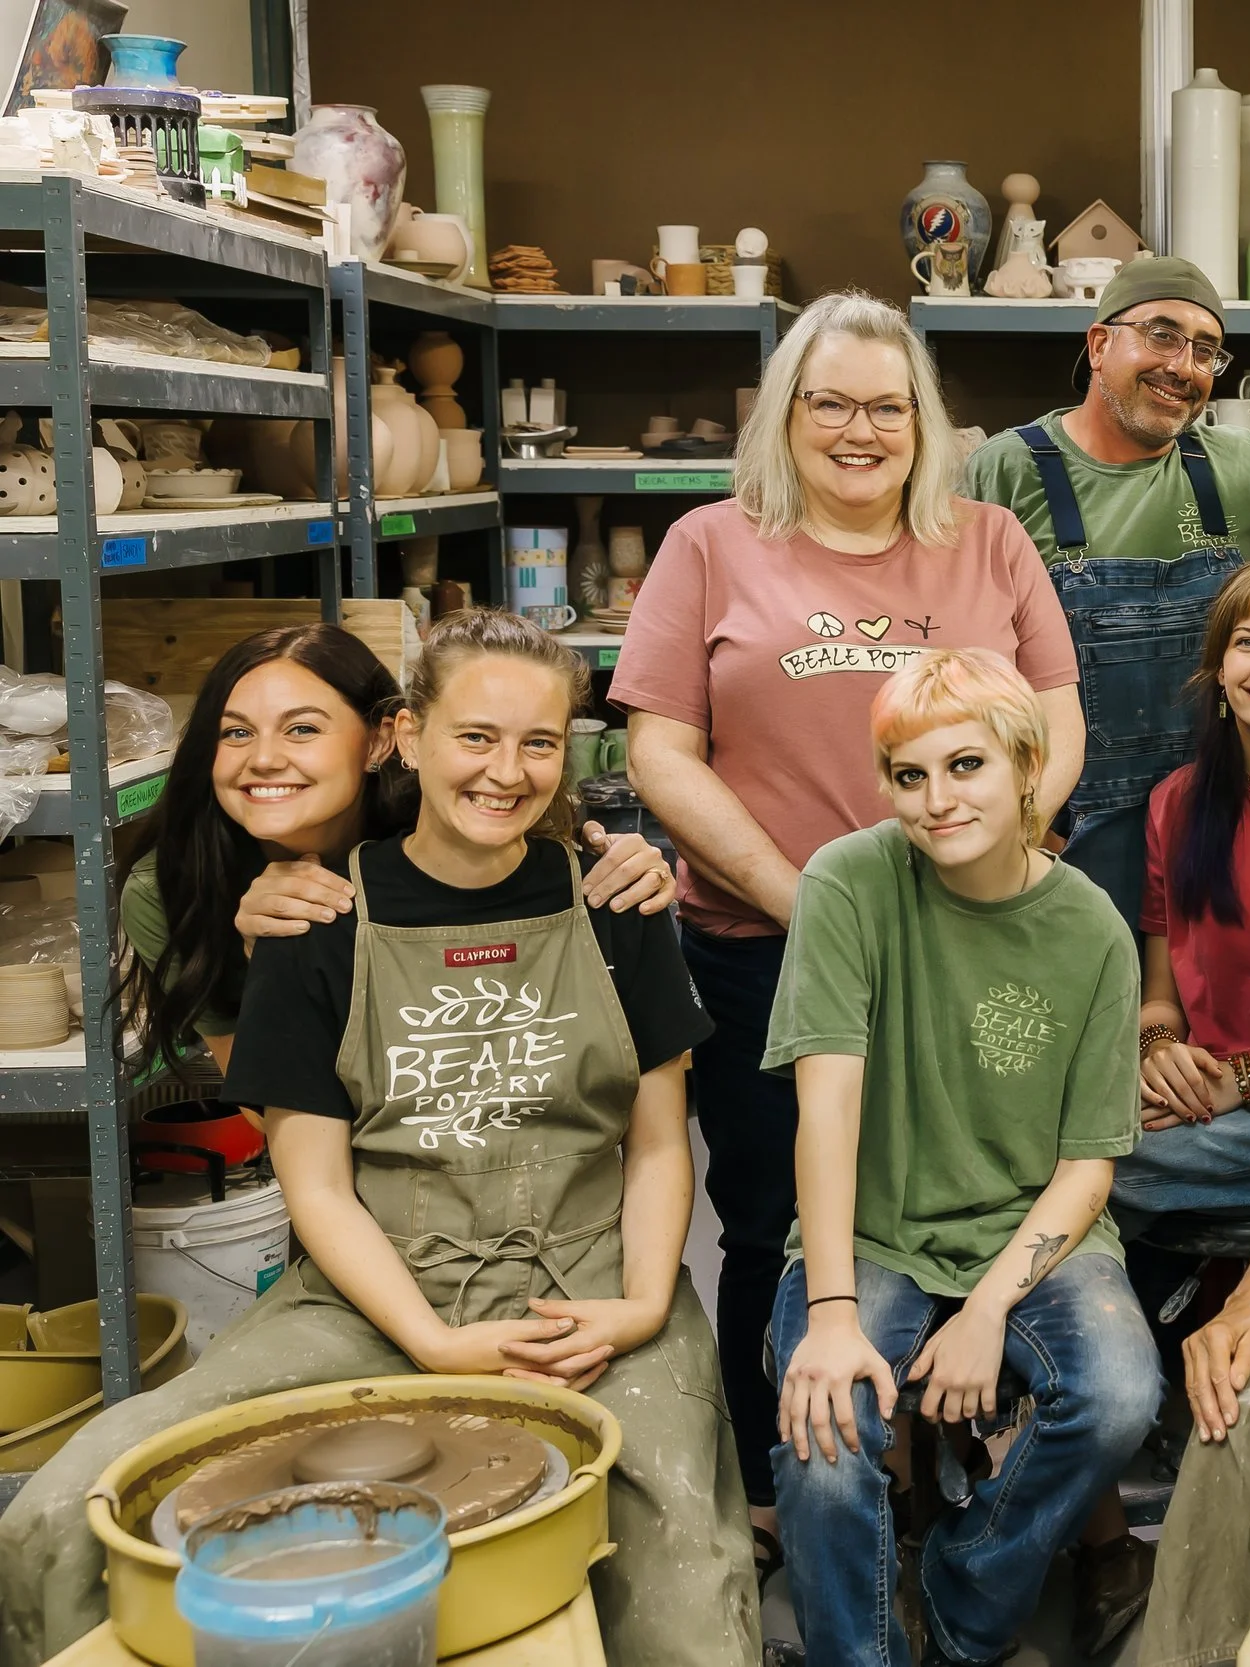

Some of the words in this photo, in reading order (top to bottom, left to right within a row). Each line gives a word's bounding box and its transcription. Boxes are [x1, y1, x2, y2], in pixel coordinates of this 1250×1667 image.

[673, 475, 702, 485] ITEMS
[785, 647, 859, 675] BEALE
[971, 1002, 1056, 1043] BEALE
[979, 1029, 1046, 1055] POTTERY
[386, 1031, 567, 1101] BEALE
[415, 1072, 552, 1113] POTTERY
